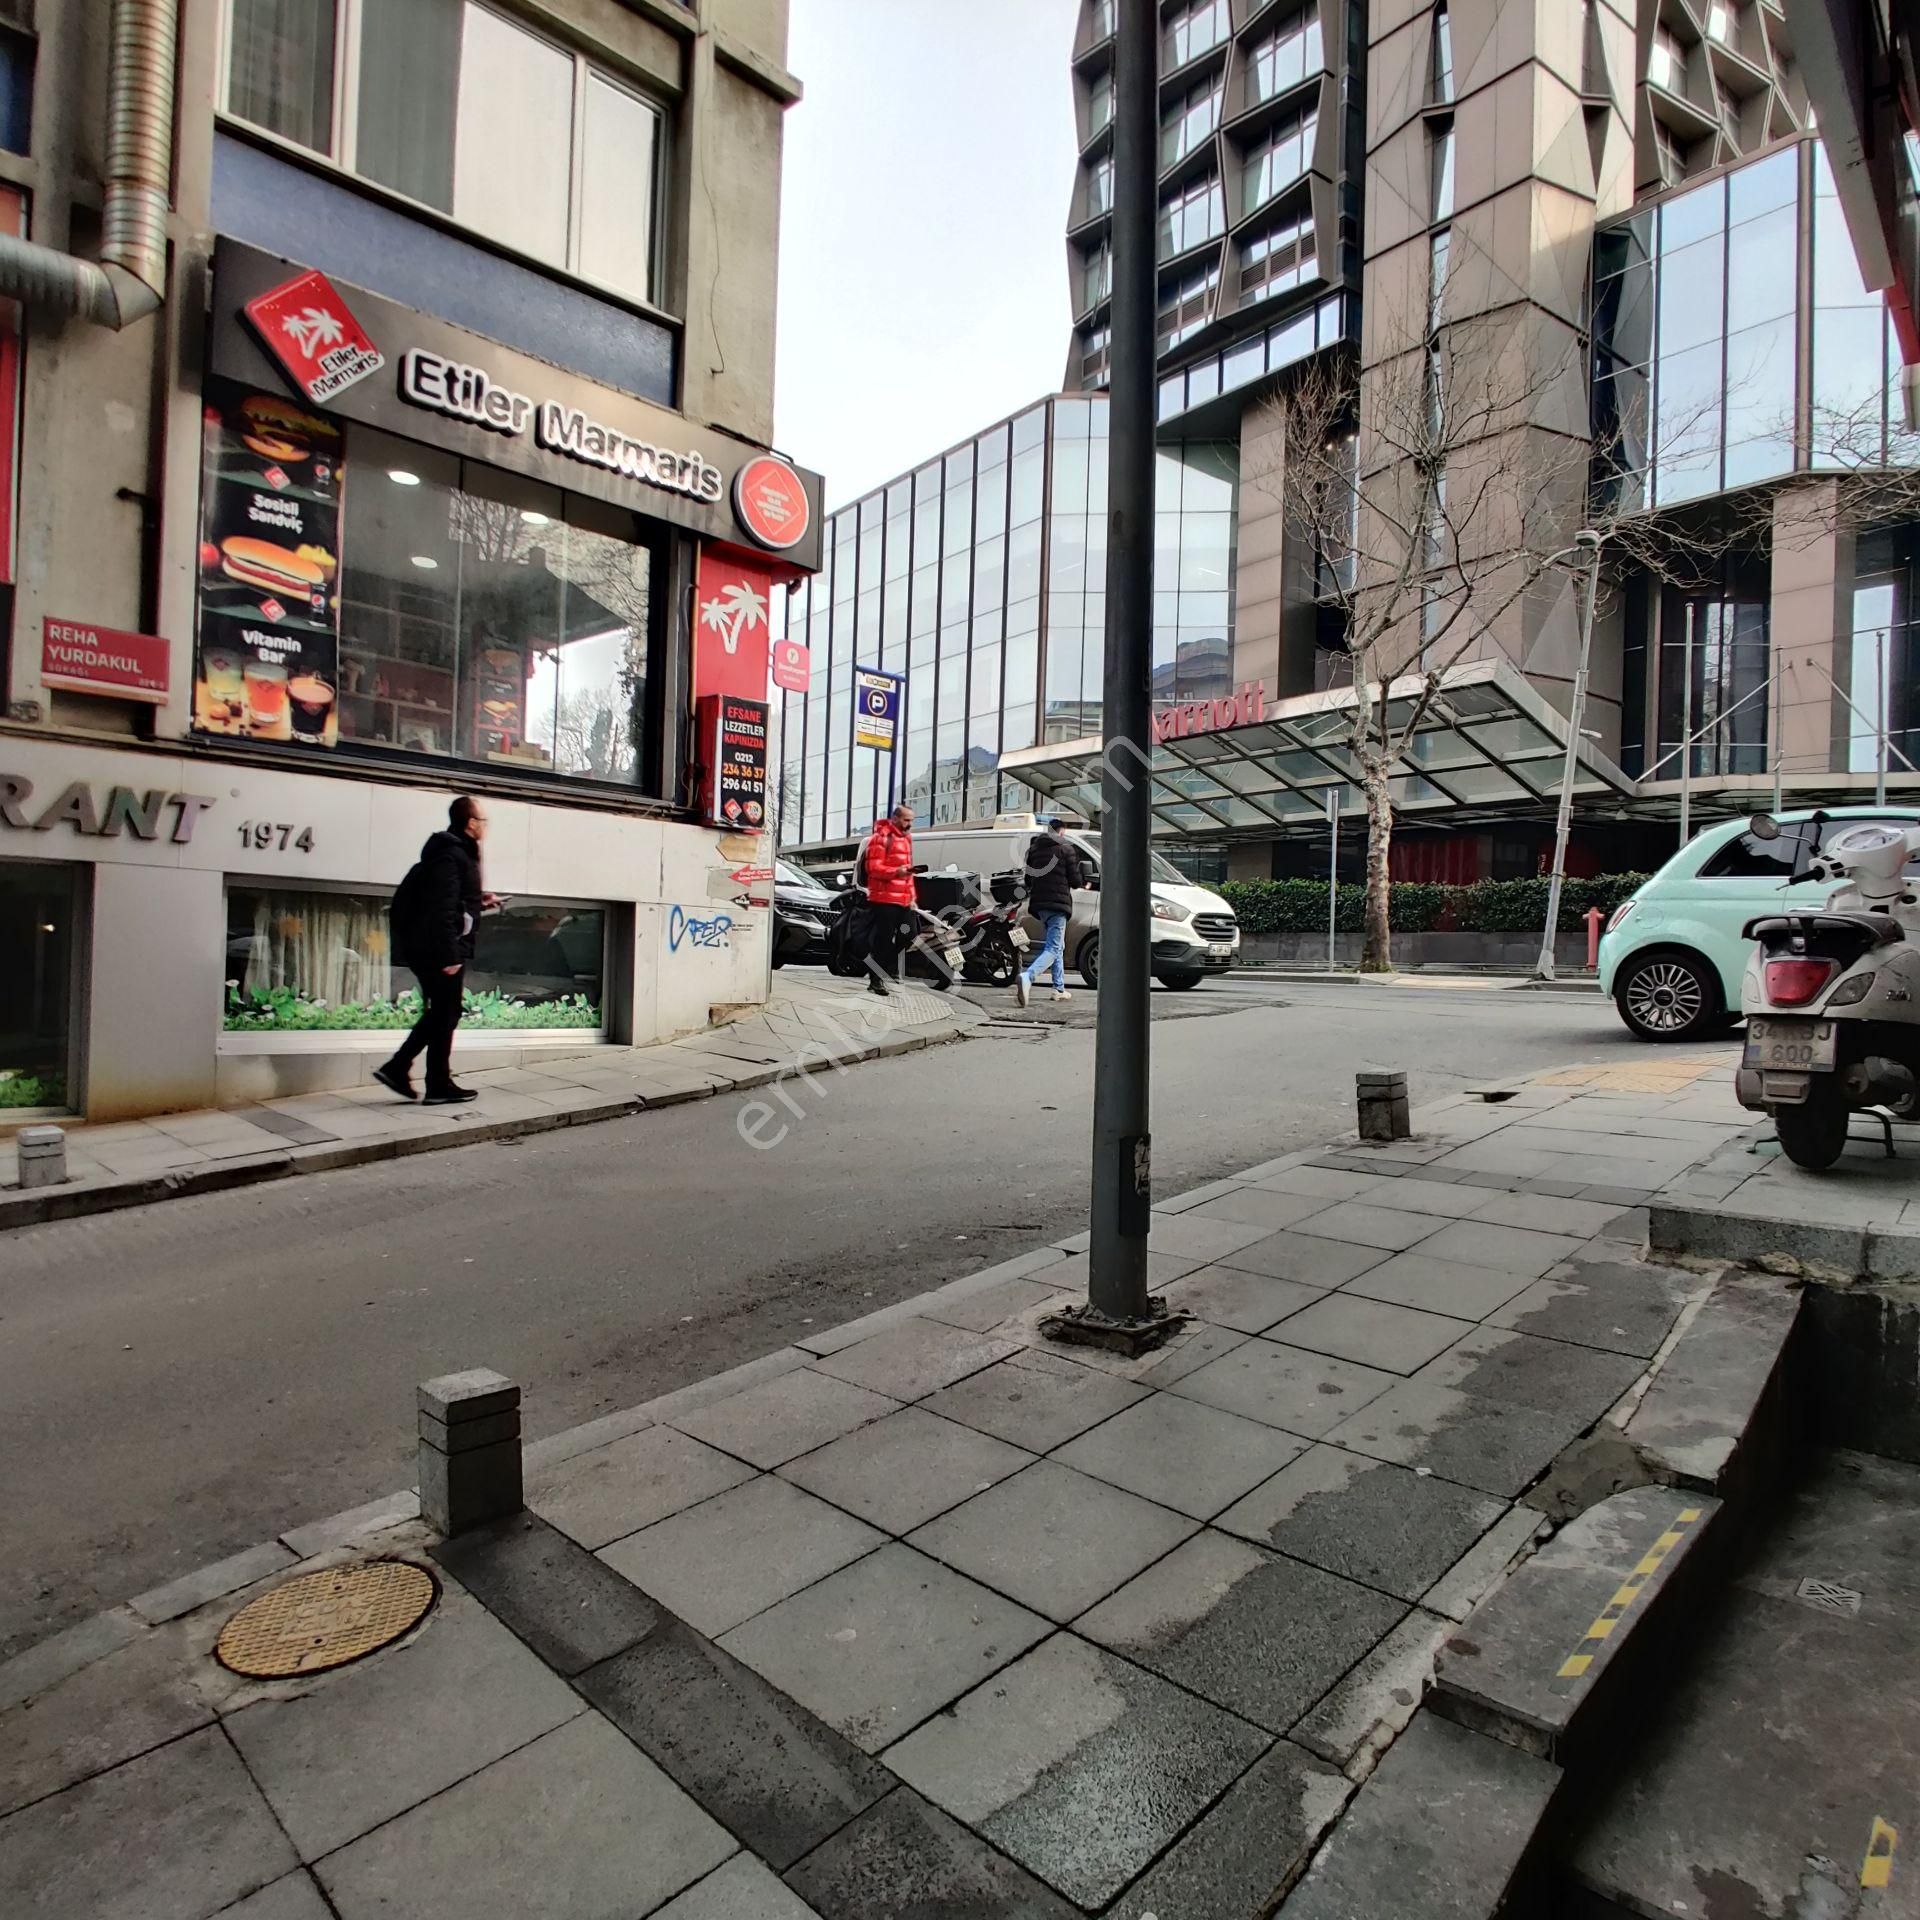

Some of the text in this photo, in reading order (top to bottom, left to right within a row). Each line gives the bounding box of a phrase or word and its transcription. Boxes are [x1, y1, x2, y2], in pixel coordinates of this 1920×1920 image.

[321, 346, 360, 373] Etiler
[312, 352, 379, 396] Marmaris
[411, 351, 721, 498] Etiler Marmaris
[253, 493, 300, 517] Sosisli
[248, 506, 304, 534] Sandviç
[48, 623, 99, 647] REHA
[242, 629, 302, 653] Vitamin
[47, 644, 143, 674] YURDAKUL
[258, 647, 286, 664] Bar
[871, 694, 884, 709] P
[727, 705, 762, 723] EFSANE
[724, 720, 765, 737] LEZZETLER
[724, 733, 765, 749] KAPINIZDA
[734, 751, 754, 764] 0212
[723, 762, 765, 779] 234 36 37
[722, 777, 764, 794] 296 41 51
[238, 820, 315, 852] 1974
[1752, 1022, 1777, 1040] 34
[1771, 1044, 1814, 1063] 600
